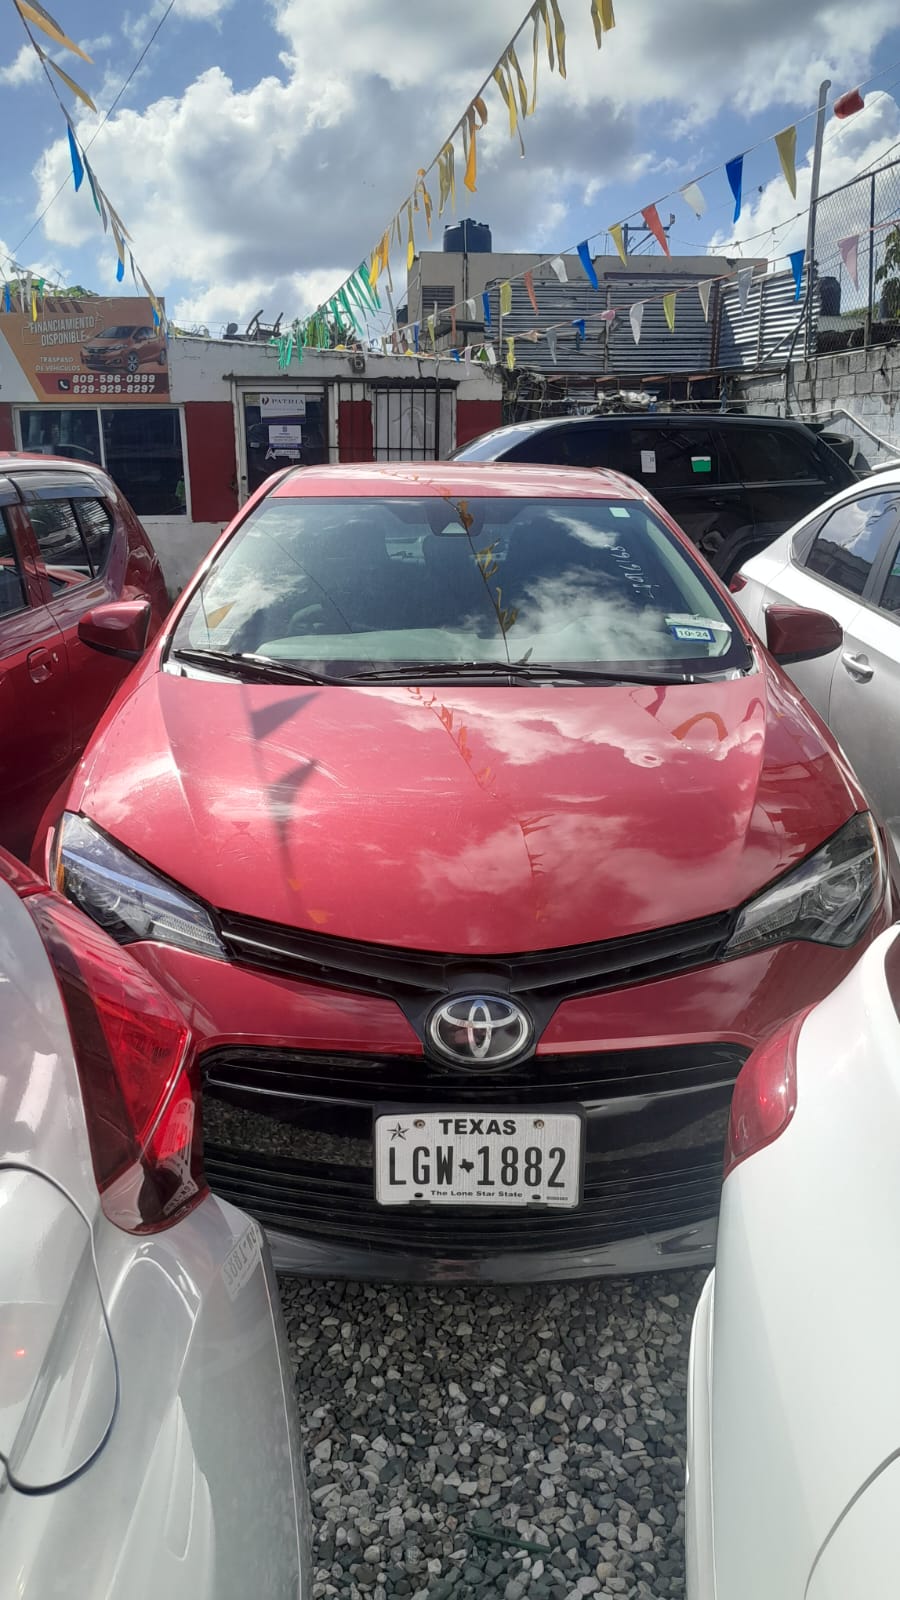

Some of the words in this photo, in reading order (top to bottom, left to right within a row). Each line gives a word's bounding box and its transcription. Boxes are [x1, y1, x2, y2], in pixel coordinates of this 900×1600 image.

[29, 315, 95, 333] FINANCIAMIENTO
[41, 330, 86, 346] DISPONIBLE
[72, 374, 156, 383] 809-596-0999
[73, 385, 156, 394] 829-929-8297
[438, 1118, 517, 1136] TEXAS
[450, 1190, 474, 1198] Lone
